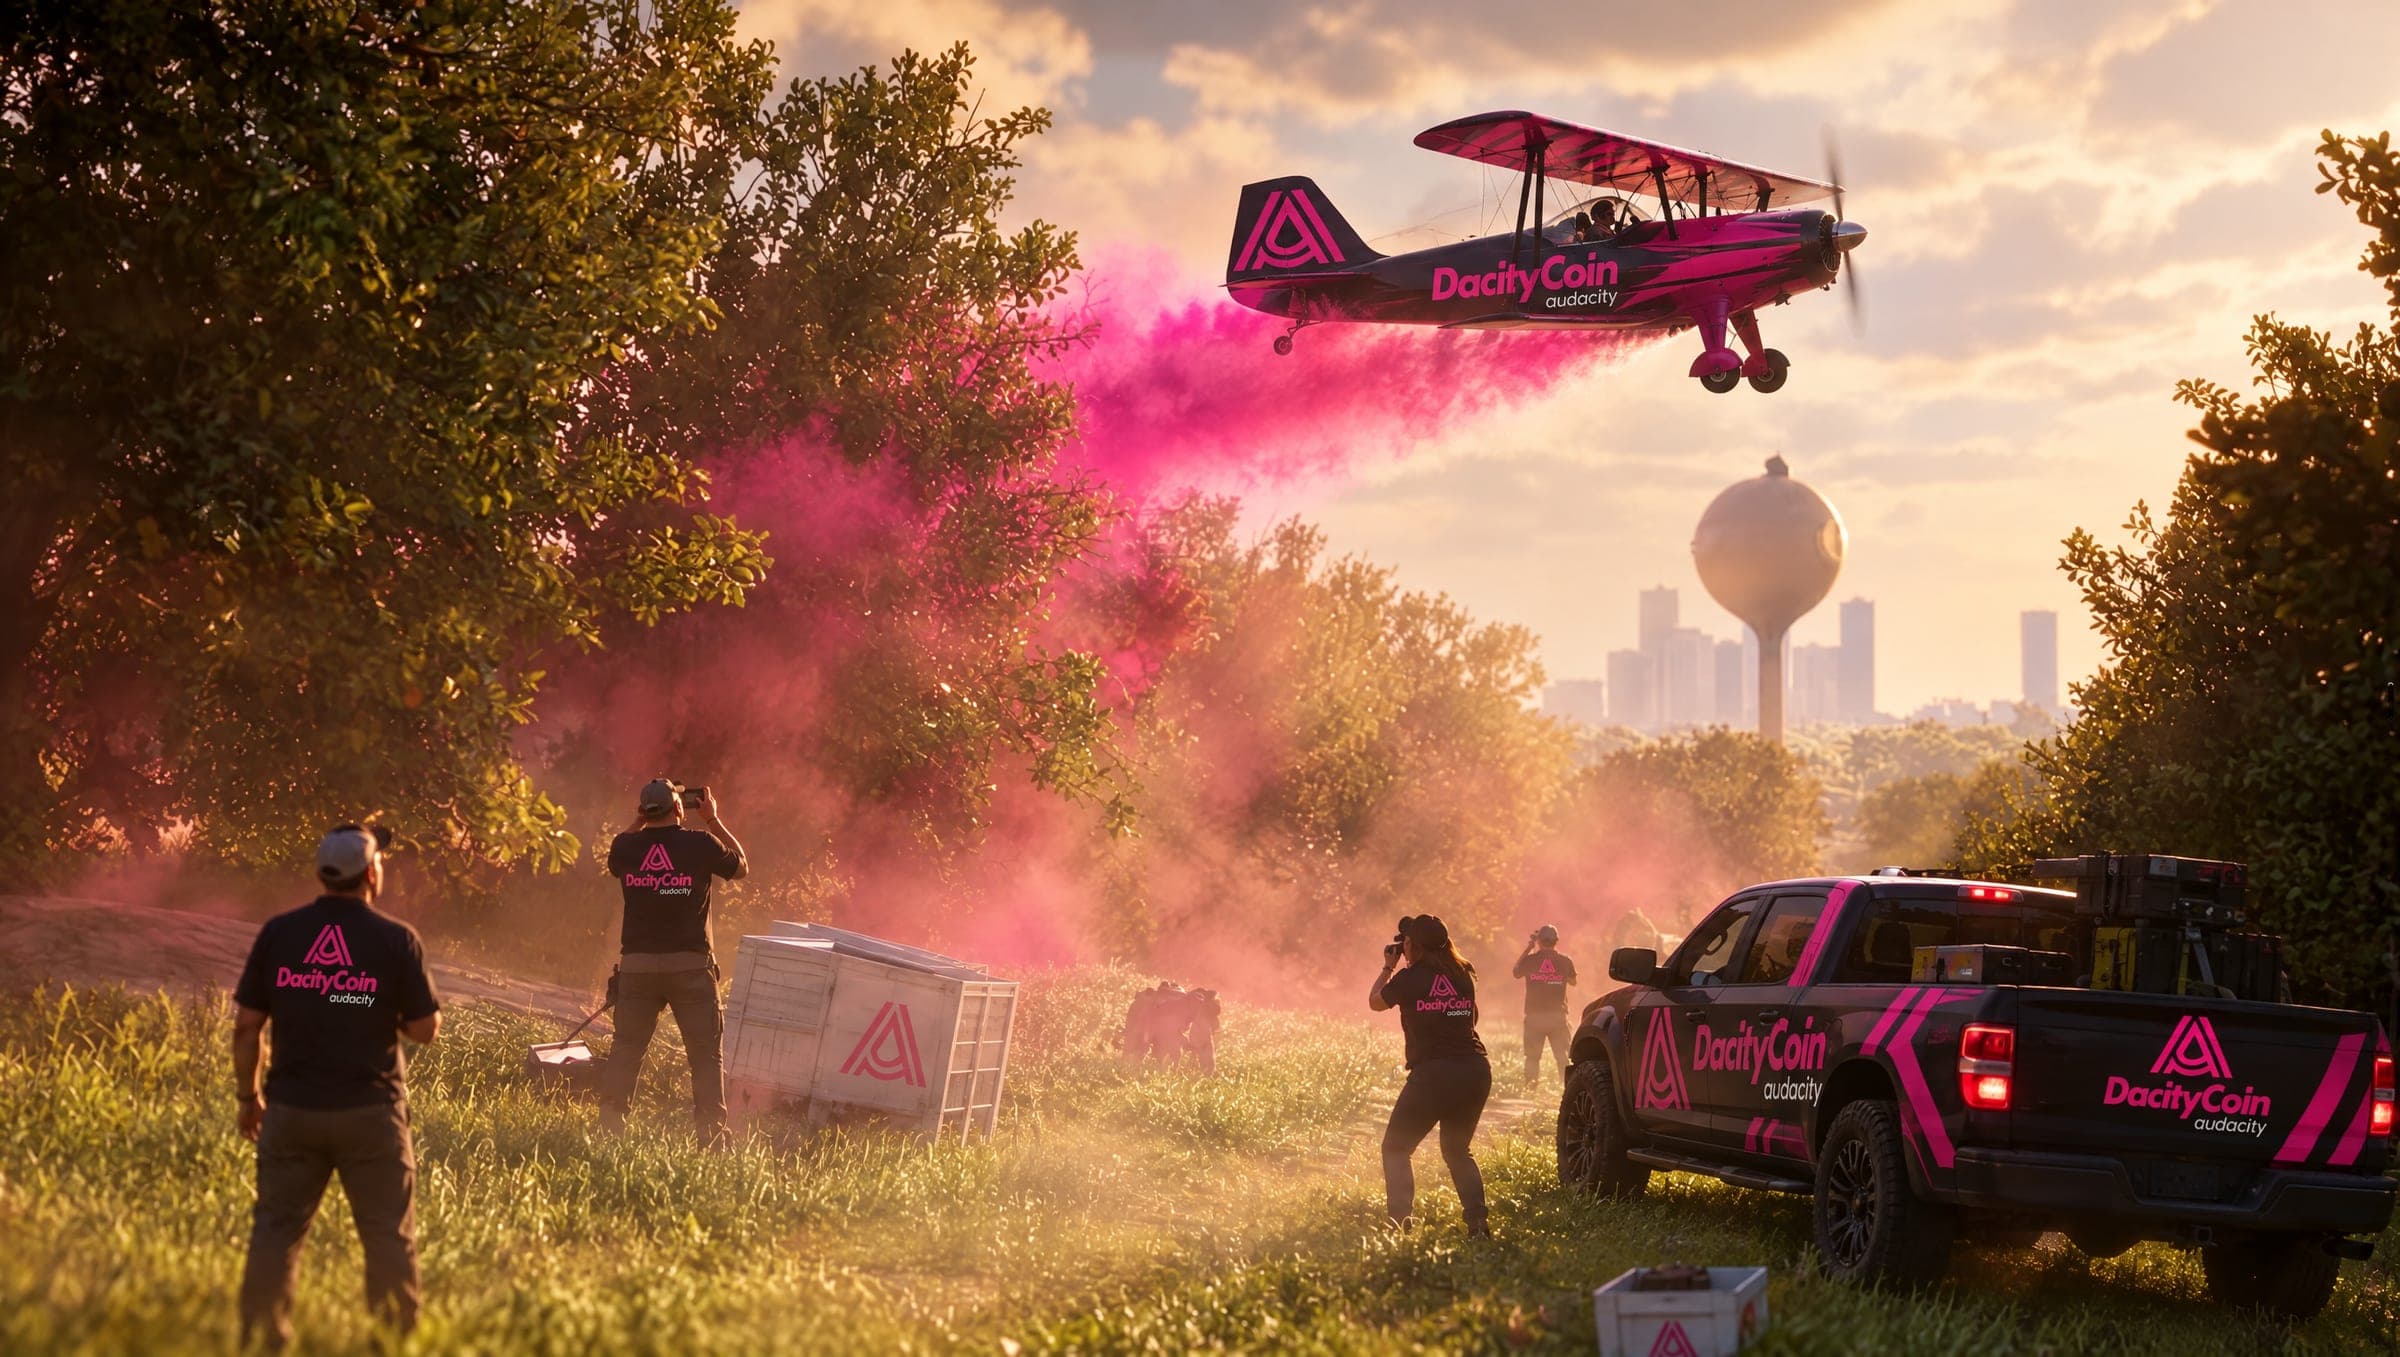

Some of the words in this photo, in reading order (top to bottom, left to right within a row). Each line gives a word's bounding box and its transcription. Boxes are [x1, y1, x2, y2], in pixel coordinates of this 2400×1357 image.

[1432, 252, 1619, 303] DacityCoin
[1546, 289, 1618, 309] audacity
[626, 873, 692, 891] DacityCoin
[276, 967, 377, 995] DacityCoin
[329, 993, 375, 1007] audacity
[1693, 1016, 1826, 1085] DacityCoin
[1764, 1076, 1822, 1107] audacity
[2103, 1076, 2271, 1119] DacityCoin
[2194, 1116, 2267, 1138] audacity
